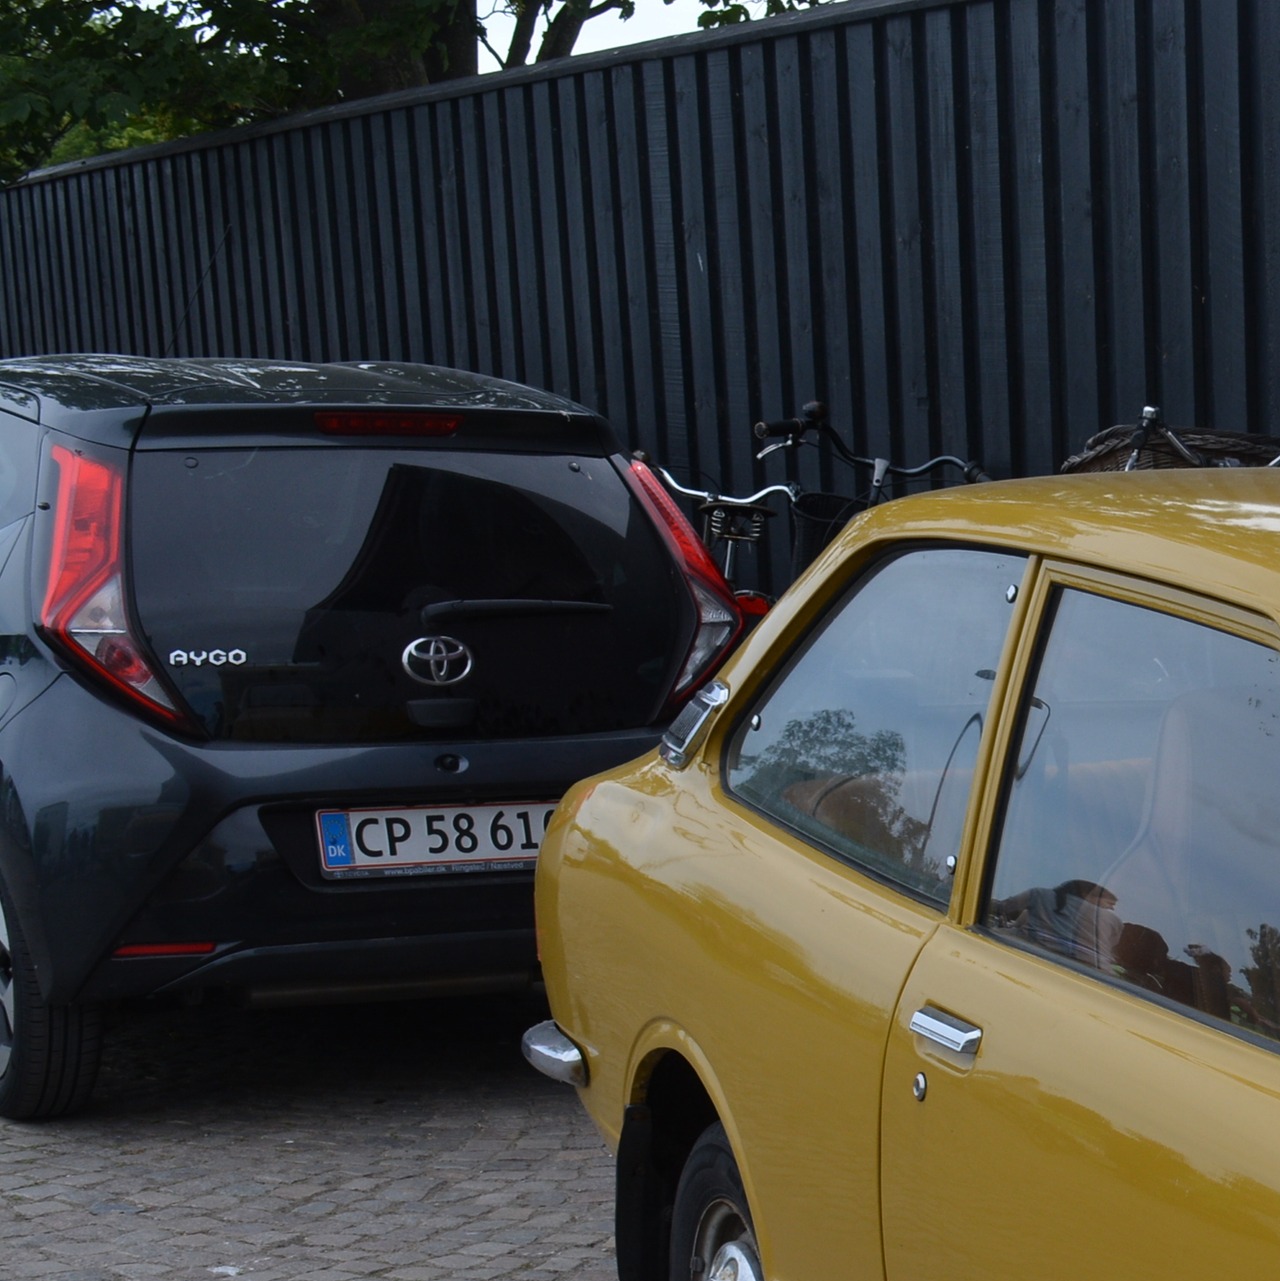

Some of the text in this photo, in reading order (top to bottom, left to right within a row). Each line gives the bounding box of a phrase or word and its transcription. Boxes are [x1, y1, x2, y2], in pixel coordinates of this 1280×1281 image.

[169, 648, 247, 667] AYGO
[355, 809, 554, 857] CP 58 61
[328, 844, 346, 858] DK
